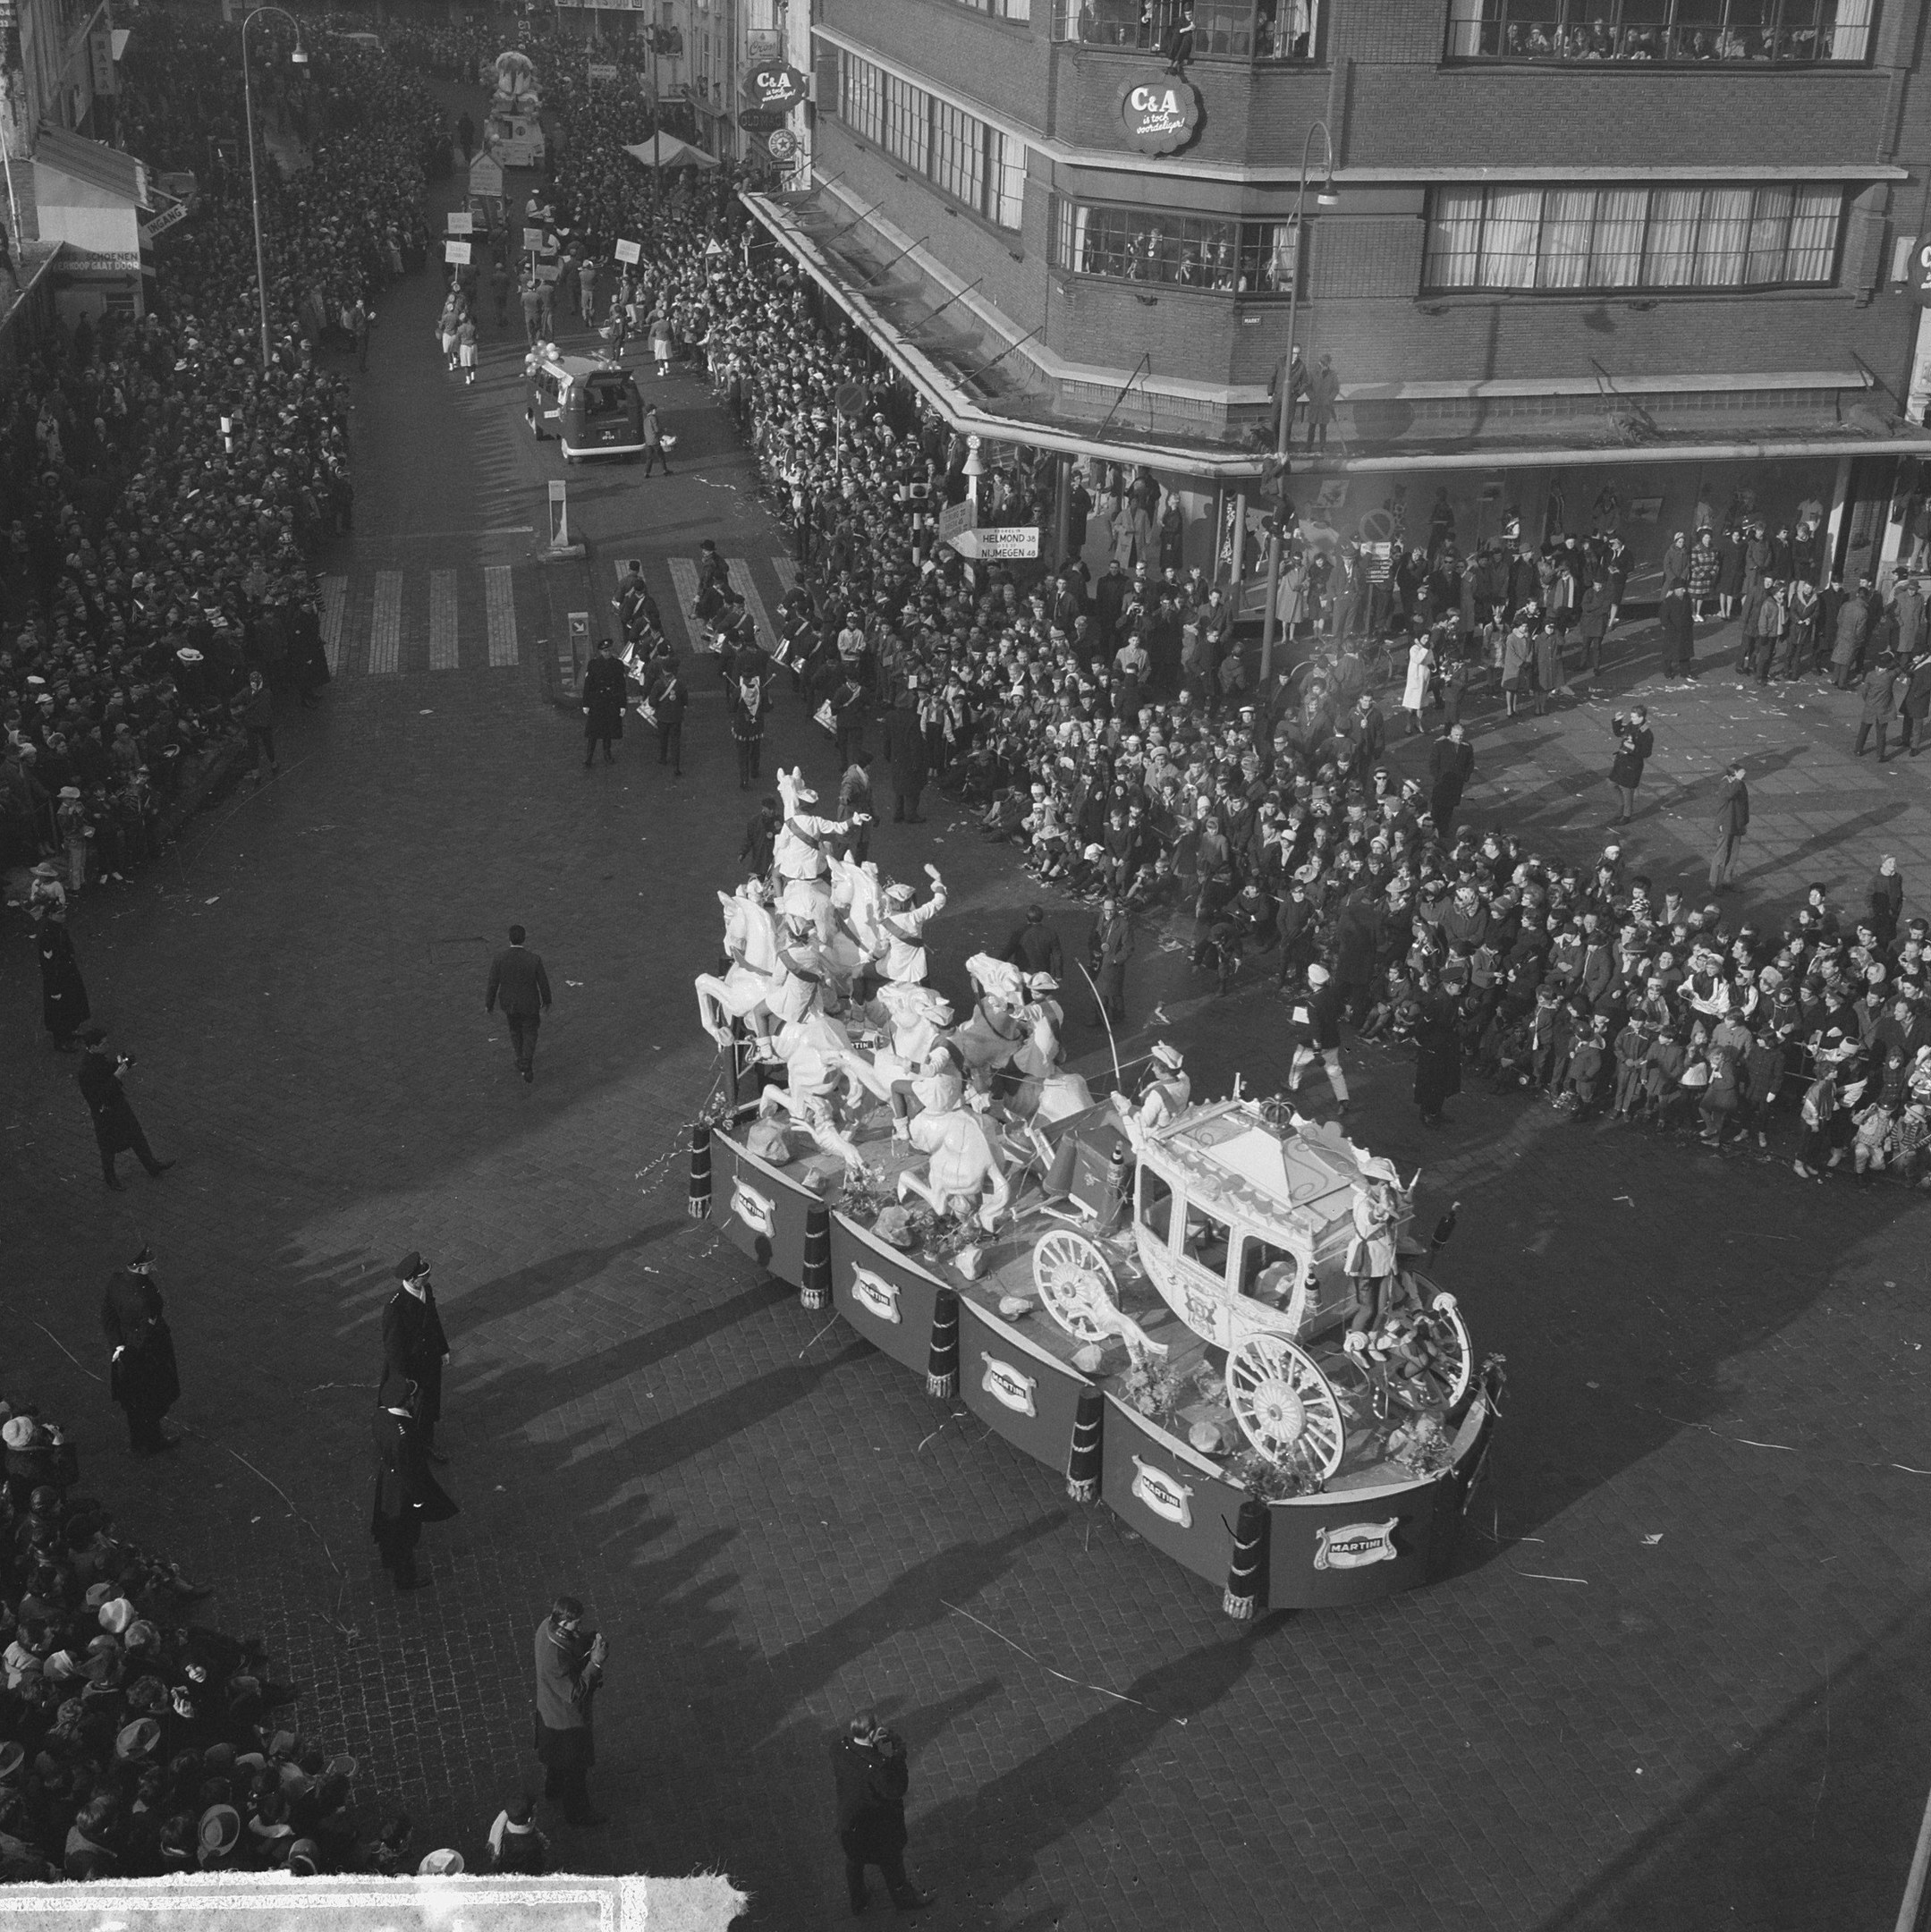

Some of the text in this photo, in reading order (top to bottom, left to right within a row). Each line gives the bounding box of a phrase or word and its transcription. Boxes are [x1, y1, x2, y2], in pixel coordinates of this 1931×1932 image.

[757, 72, 792, 88] C&A
[1131, 87, 1180, 114] C&A
[1136, 116, 1185, 134] voordeliger!
[1143, 111, 1170, 124] is toch
[147, 205, 182, 234] INGANG
[85, 252, 139, 261] SCHOENEN
[91, 260, 114, 270] GAAT
[114, 260, 140, 270] DOOR
[982, 534, 1025, 543] HELMOND
[981, 548, 1025, 557] NIJMEGEN
[739, 1193, 765, 1220] MARTINI
[860, 1280, 890, 1306] MARTINI
[992, 1371, 1026, 1398] MARTINI
[1143, 1478, 1181, 1507] MARTINI
[1331, 1539, 1381, 1552] MARTINI
